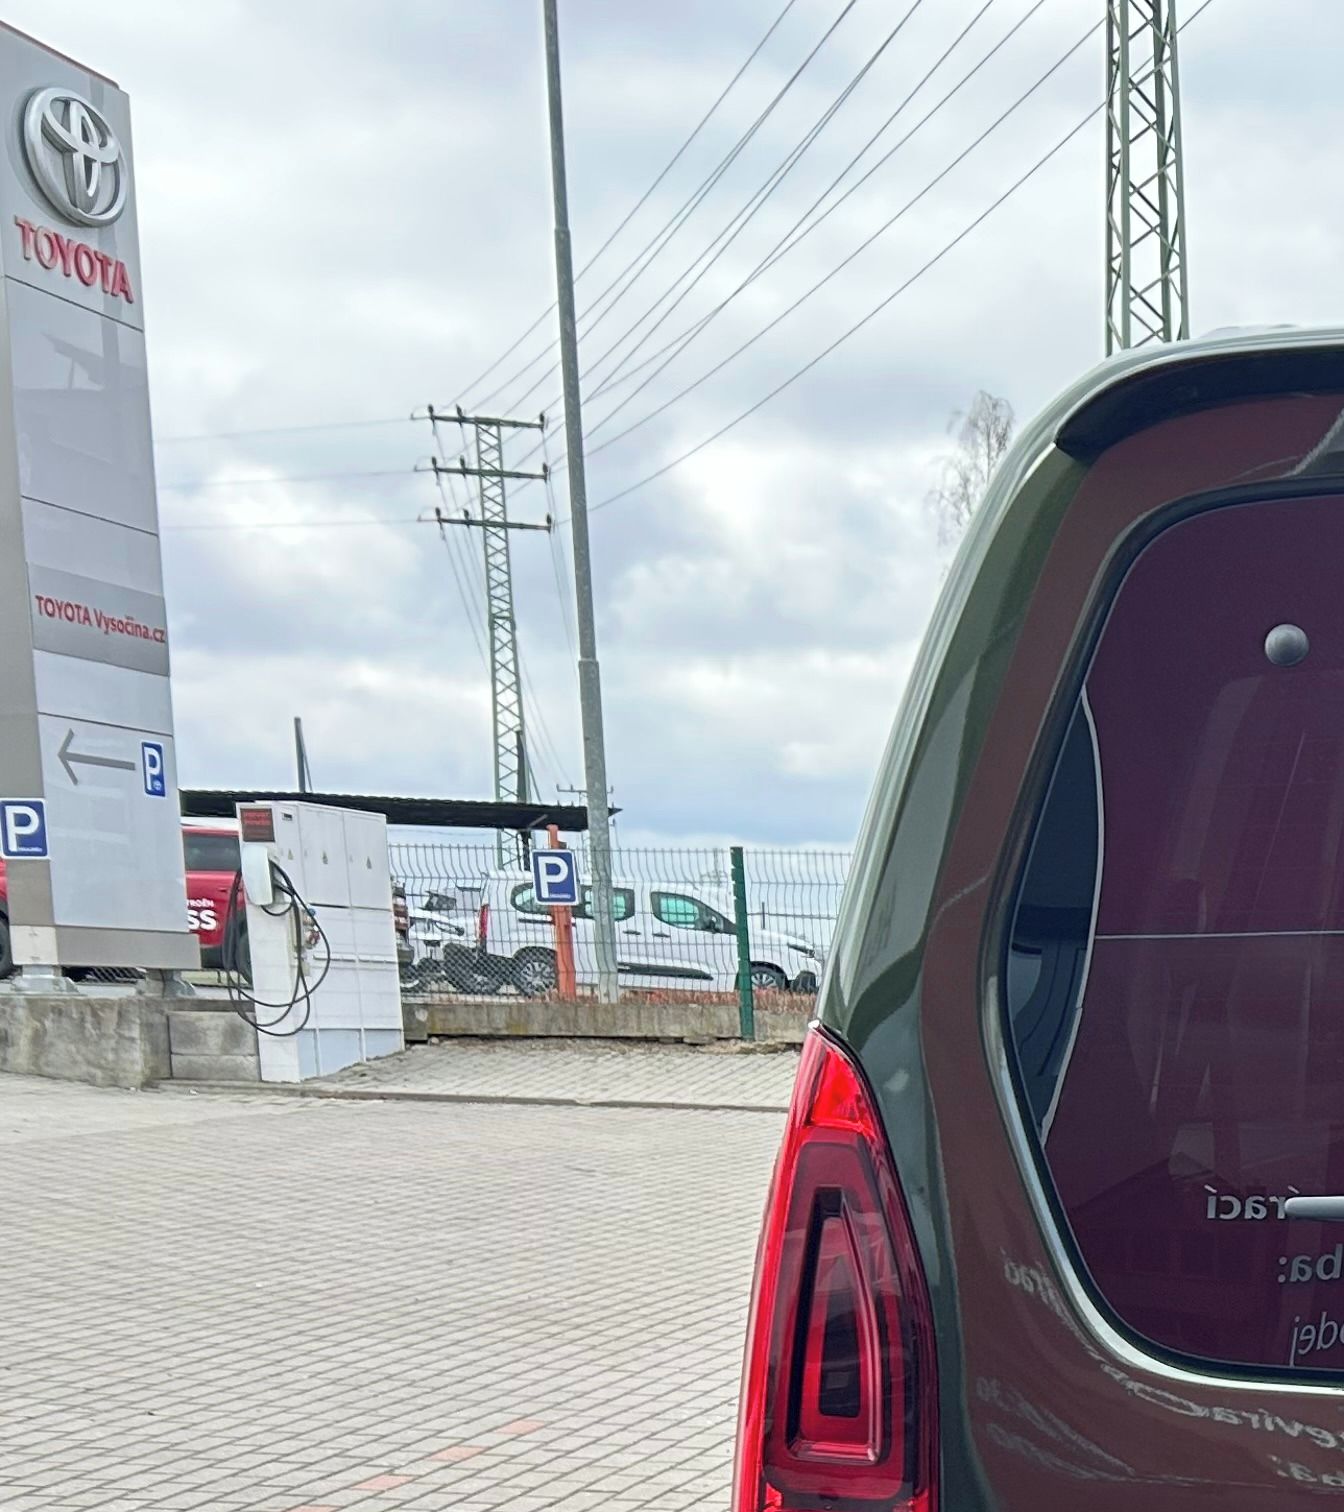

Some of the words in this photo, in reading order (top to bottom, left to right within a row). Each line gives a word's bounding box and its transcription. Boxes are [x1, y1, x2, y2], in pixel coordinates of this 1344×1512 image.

[14, 215, 134, 304] TOYOTA
[35, 595, 92, 627] TOYOTA
[93, 608, 166, 643] Vysočina.cz
[144, 746, 161, 790] P
[4, 805, 40, 852] P
[538, 856, 568, 898] P
